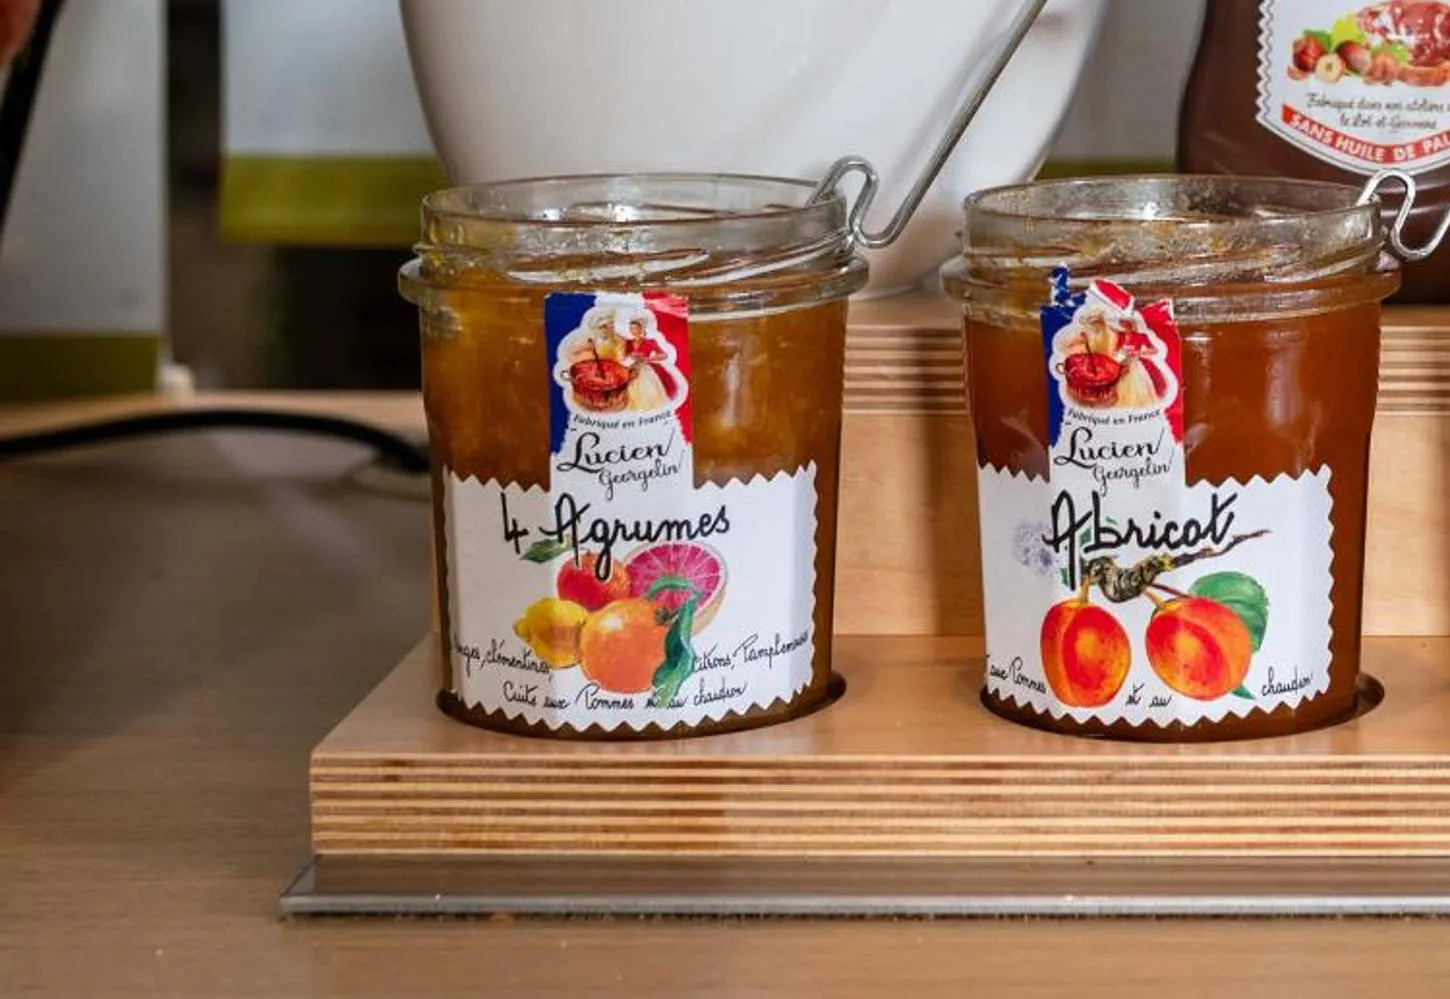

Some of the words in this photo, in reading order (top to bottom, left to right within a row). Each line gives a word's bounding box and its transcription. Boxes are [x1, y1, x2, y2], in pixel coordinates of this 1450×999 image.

[1290, 111, 1335, 144] SANS
[1336, 133, 1385, 162] HUILE
[1391, 146, 1416, 162] DE
[556, 428, 676, 474] Lucien
[1053, 427, 1165, 469] Lucien
[599, 455, 683, 501] Georgelin
[1093, 453, 1173, 497] Georgelin
[500, 490, 529, 554] 4
[539, 492, 731, 581] Agrumes
[1042, 489, 1238, 592] Abricot
[576, 683, 634, 710] Pommes
